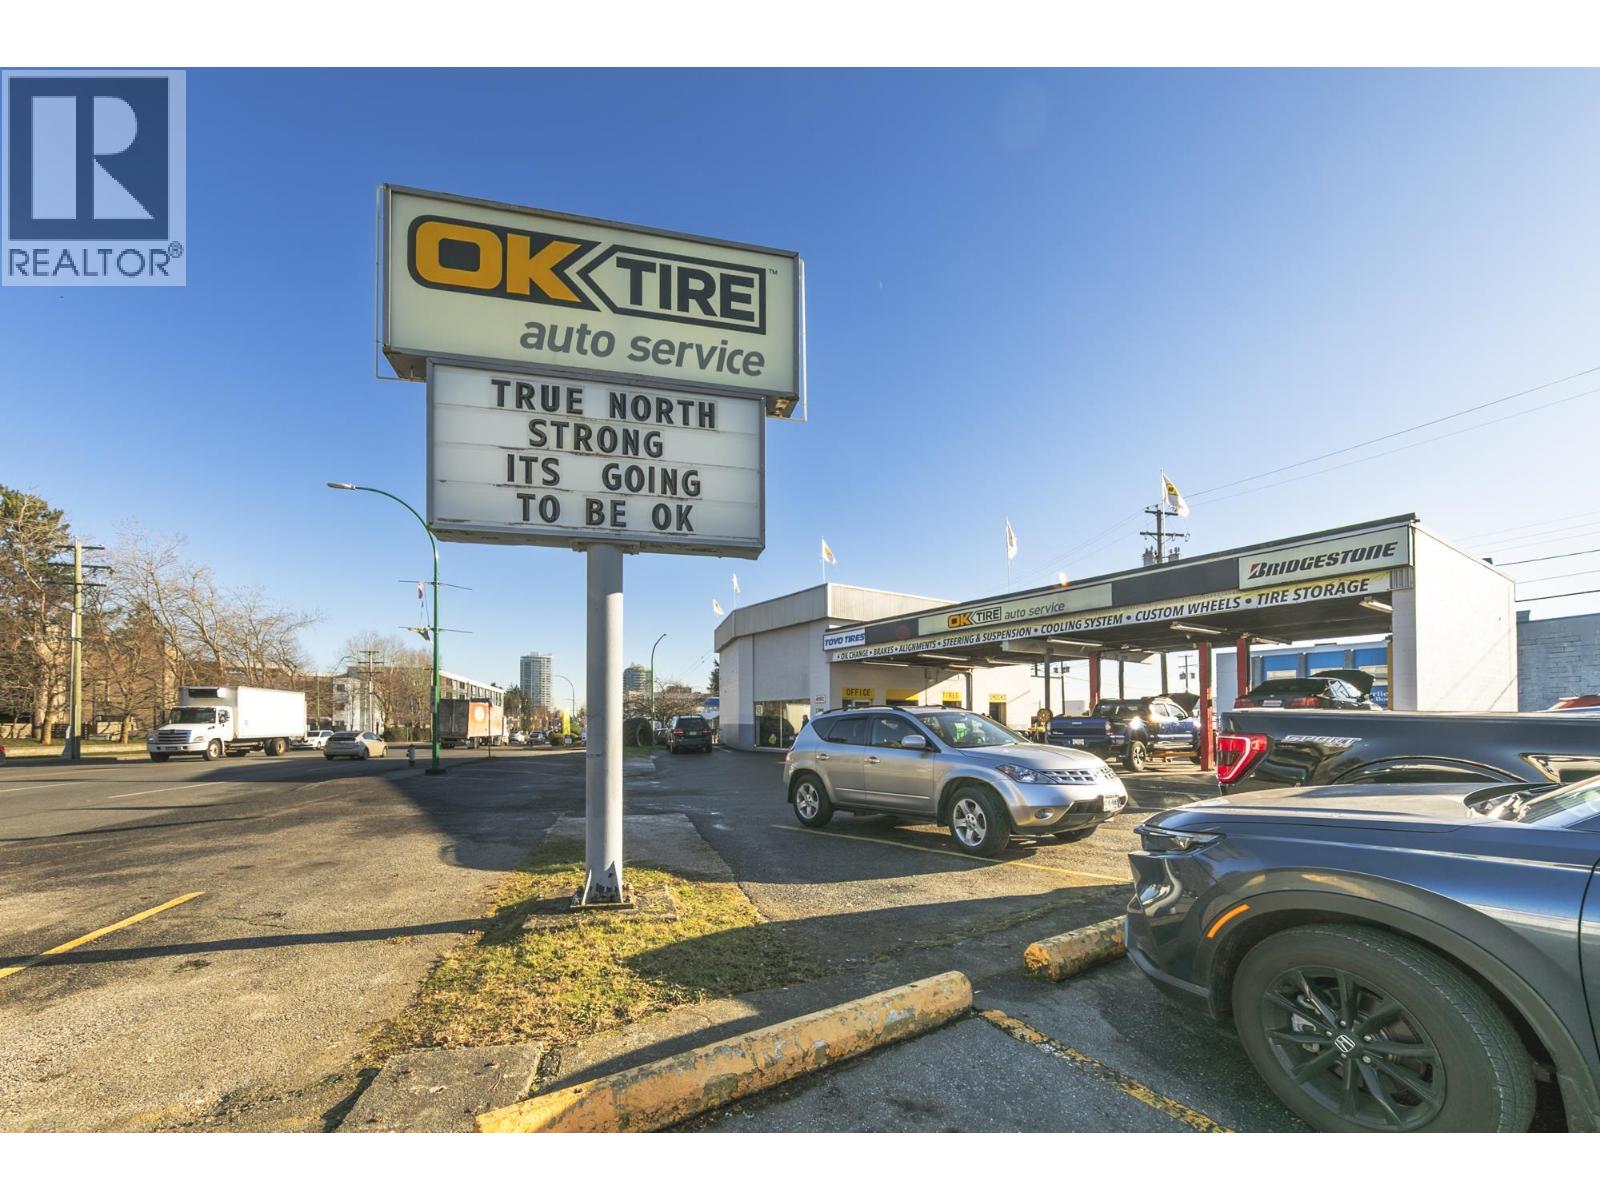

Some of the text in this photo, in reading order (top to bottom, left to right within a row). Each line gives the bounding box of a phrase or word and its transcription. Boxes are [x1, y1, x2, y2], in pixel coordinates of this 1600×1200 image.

[414, 219, 584, 304] OK
[615, 255, 756, 323] TIRE
[520, 320, 766, 377] auto service
[491, 378, 717, 429] TRUE NORTH
[528, 418, 664, 459] STRONG
[507, 453, 702, 497] ITS GOING
[516, 493, 695, 533] TO BE OK
[1248, 541, 1399, 580] BRIDGESTONE
[840, 578, 1370, 660] OIL CHANGE BRAKES ALIGNMENTS STEERING & SUSPENSION COOLING SYSTEM CUSTOM WHEELS TIRE STORAGE
[948, 602, 1065, 628] OK TIRE auto service
[844, 633, 865, 643] TIRES
[846, 688, 871, 697] OFFICE
